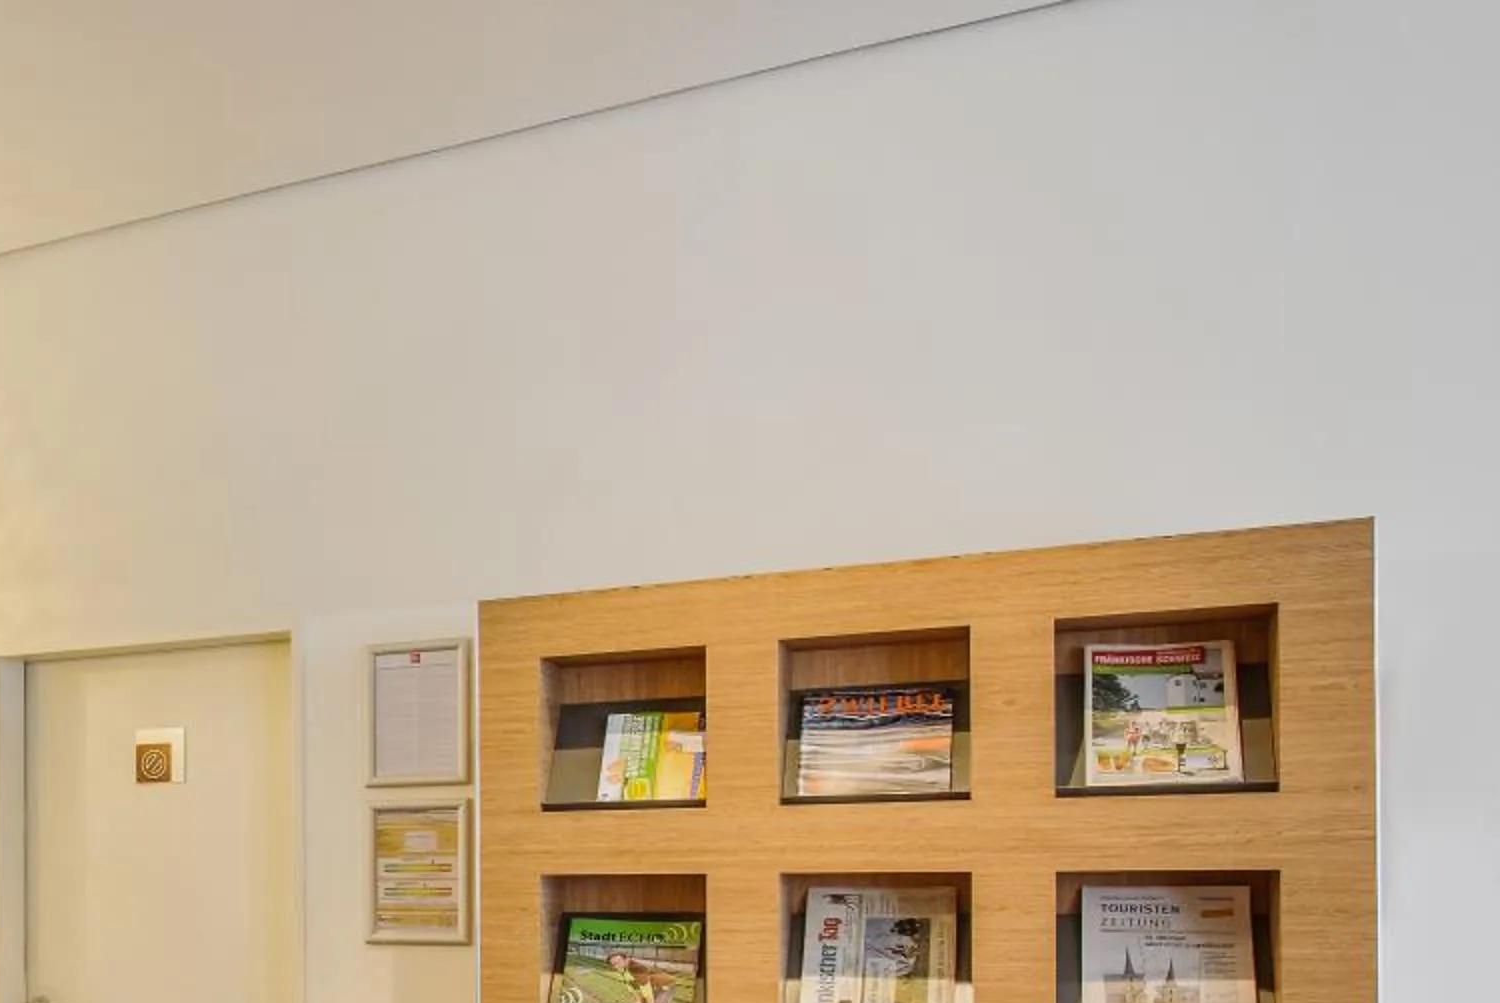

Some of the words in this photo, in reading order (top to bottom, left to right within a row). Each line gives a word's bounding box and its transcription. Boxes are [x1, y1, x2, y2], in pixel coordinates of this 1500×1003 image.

[1101, 903, 1180, 914] TOURISTEN
[1100, 917, 1170, 928] ZEITUNG
[819, 917, 842, 942] Tag
